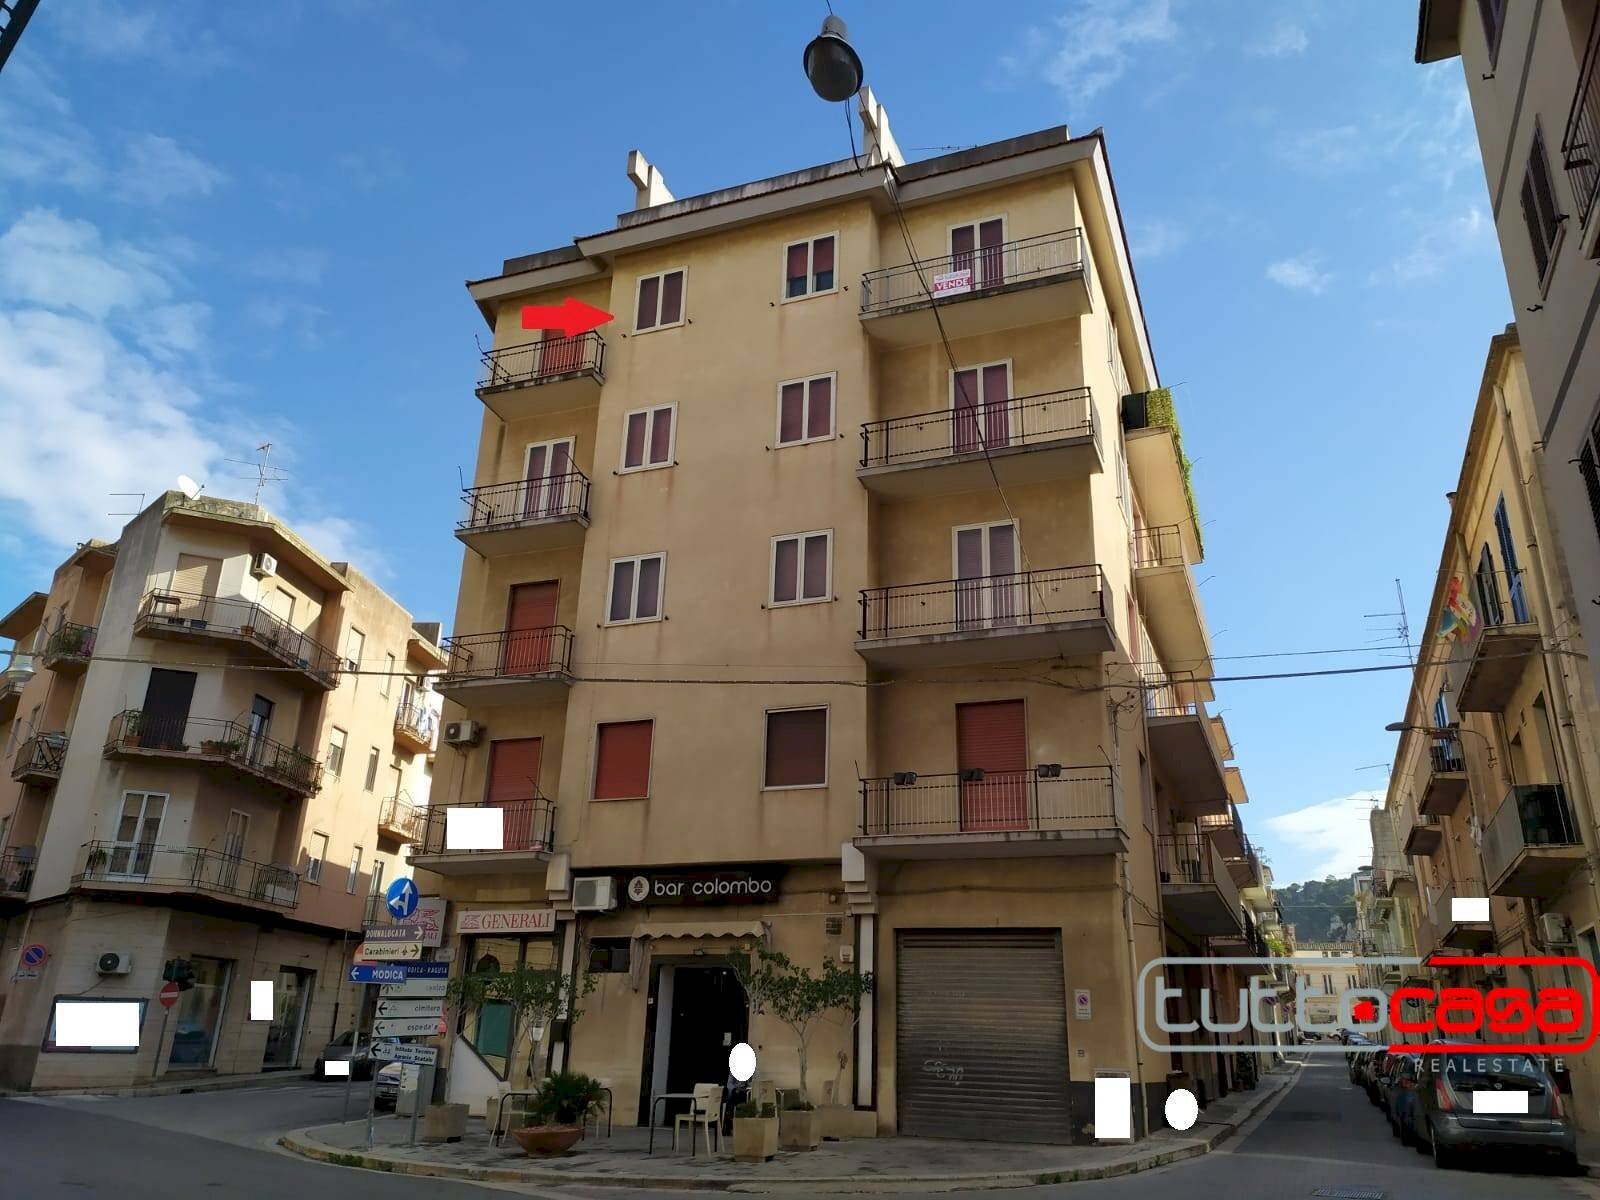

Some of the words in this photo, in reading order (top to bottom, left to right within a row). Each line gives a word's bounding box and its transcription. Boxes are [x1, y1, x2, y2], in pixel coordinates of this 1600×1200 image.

[936, 278, 969, 290] VENDE
[654, 880, 684, 896] bar
[692, 877, 772, 895] colombo
[481, 912, 551, 930] GENERALI
[364, 946, 400, 956] Carabinieri
[371, 969, 404, 980] MODICA
